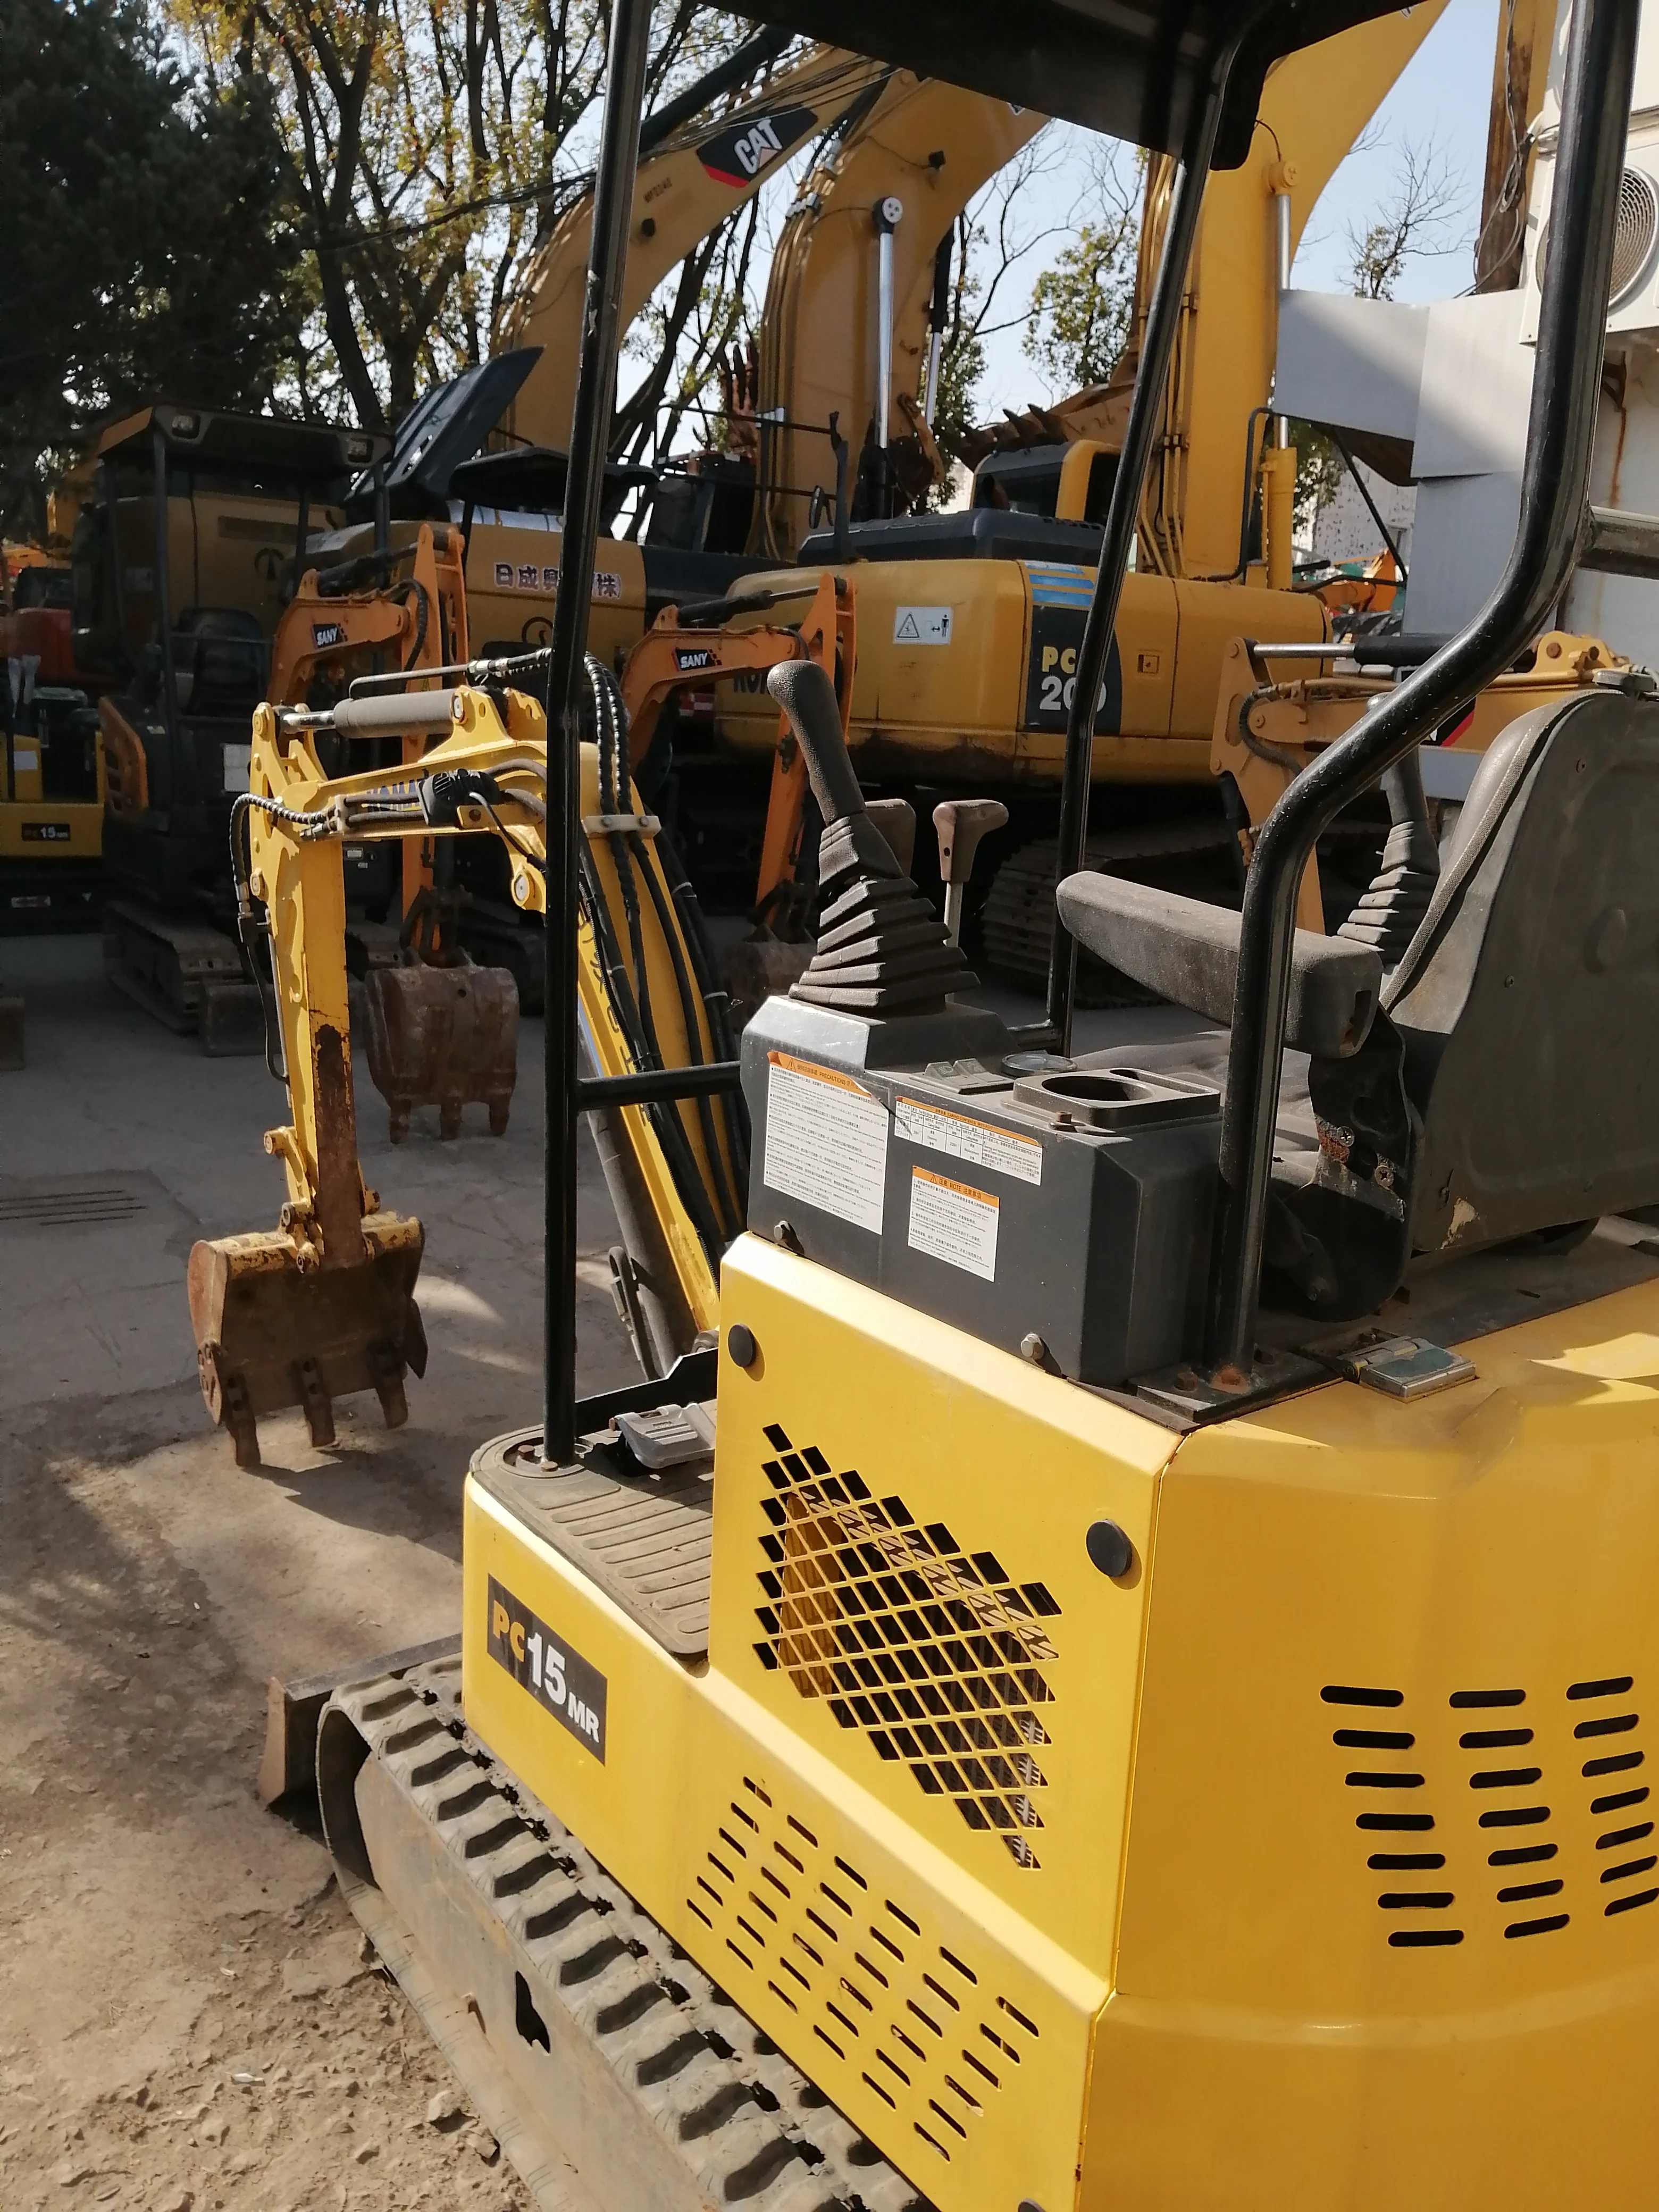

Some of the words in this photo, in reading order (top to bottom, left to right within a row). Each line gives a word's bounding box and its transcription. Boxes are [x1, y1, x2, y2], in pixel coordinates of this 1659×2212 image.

[734, 119, 783, 174] CAT
[316, 626, 338, 646] SANY
[680, 652, 708, 669] SANY
[1042, 646, 1077, 674] PC
[819, 1071, 847, 1085] PRECAUTIONS
[950, 1183, 961, 1192] NOTE
